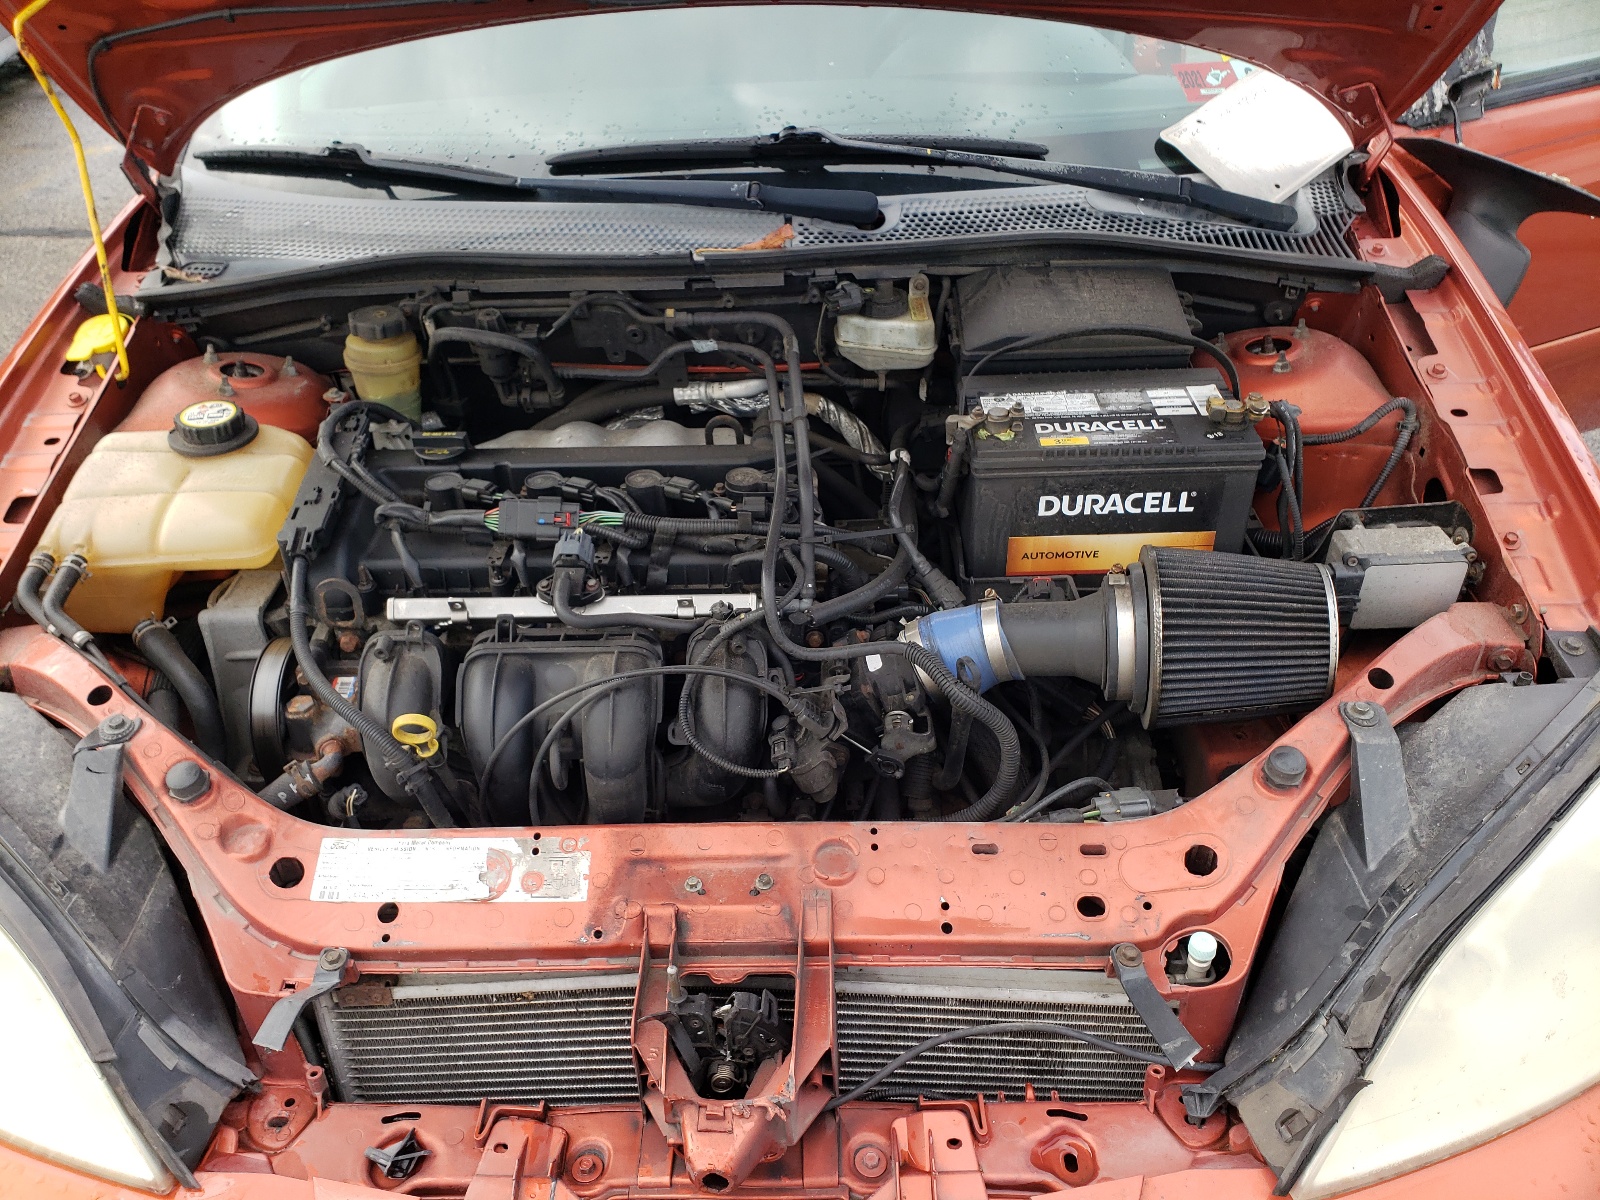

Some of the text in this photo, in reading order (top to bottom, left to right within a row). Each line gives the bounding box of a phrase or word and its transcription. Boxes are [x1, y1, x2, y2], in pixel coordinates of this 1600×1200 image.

[1178, 70, 1207, 89] 2021
[1035, 418, 1166, 434] DURACELL
[1037, 491, 1194, 517] DURACELL
[1020, 549, 1100, 560] AUTOMOTIVE
